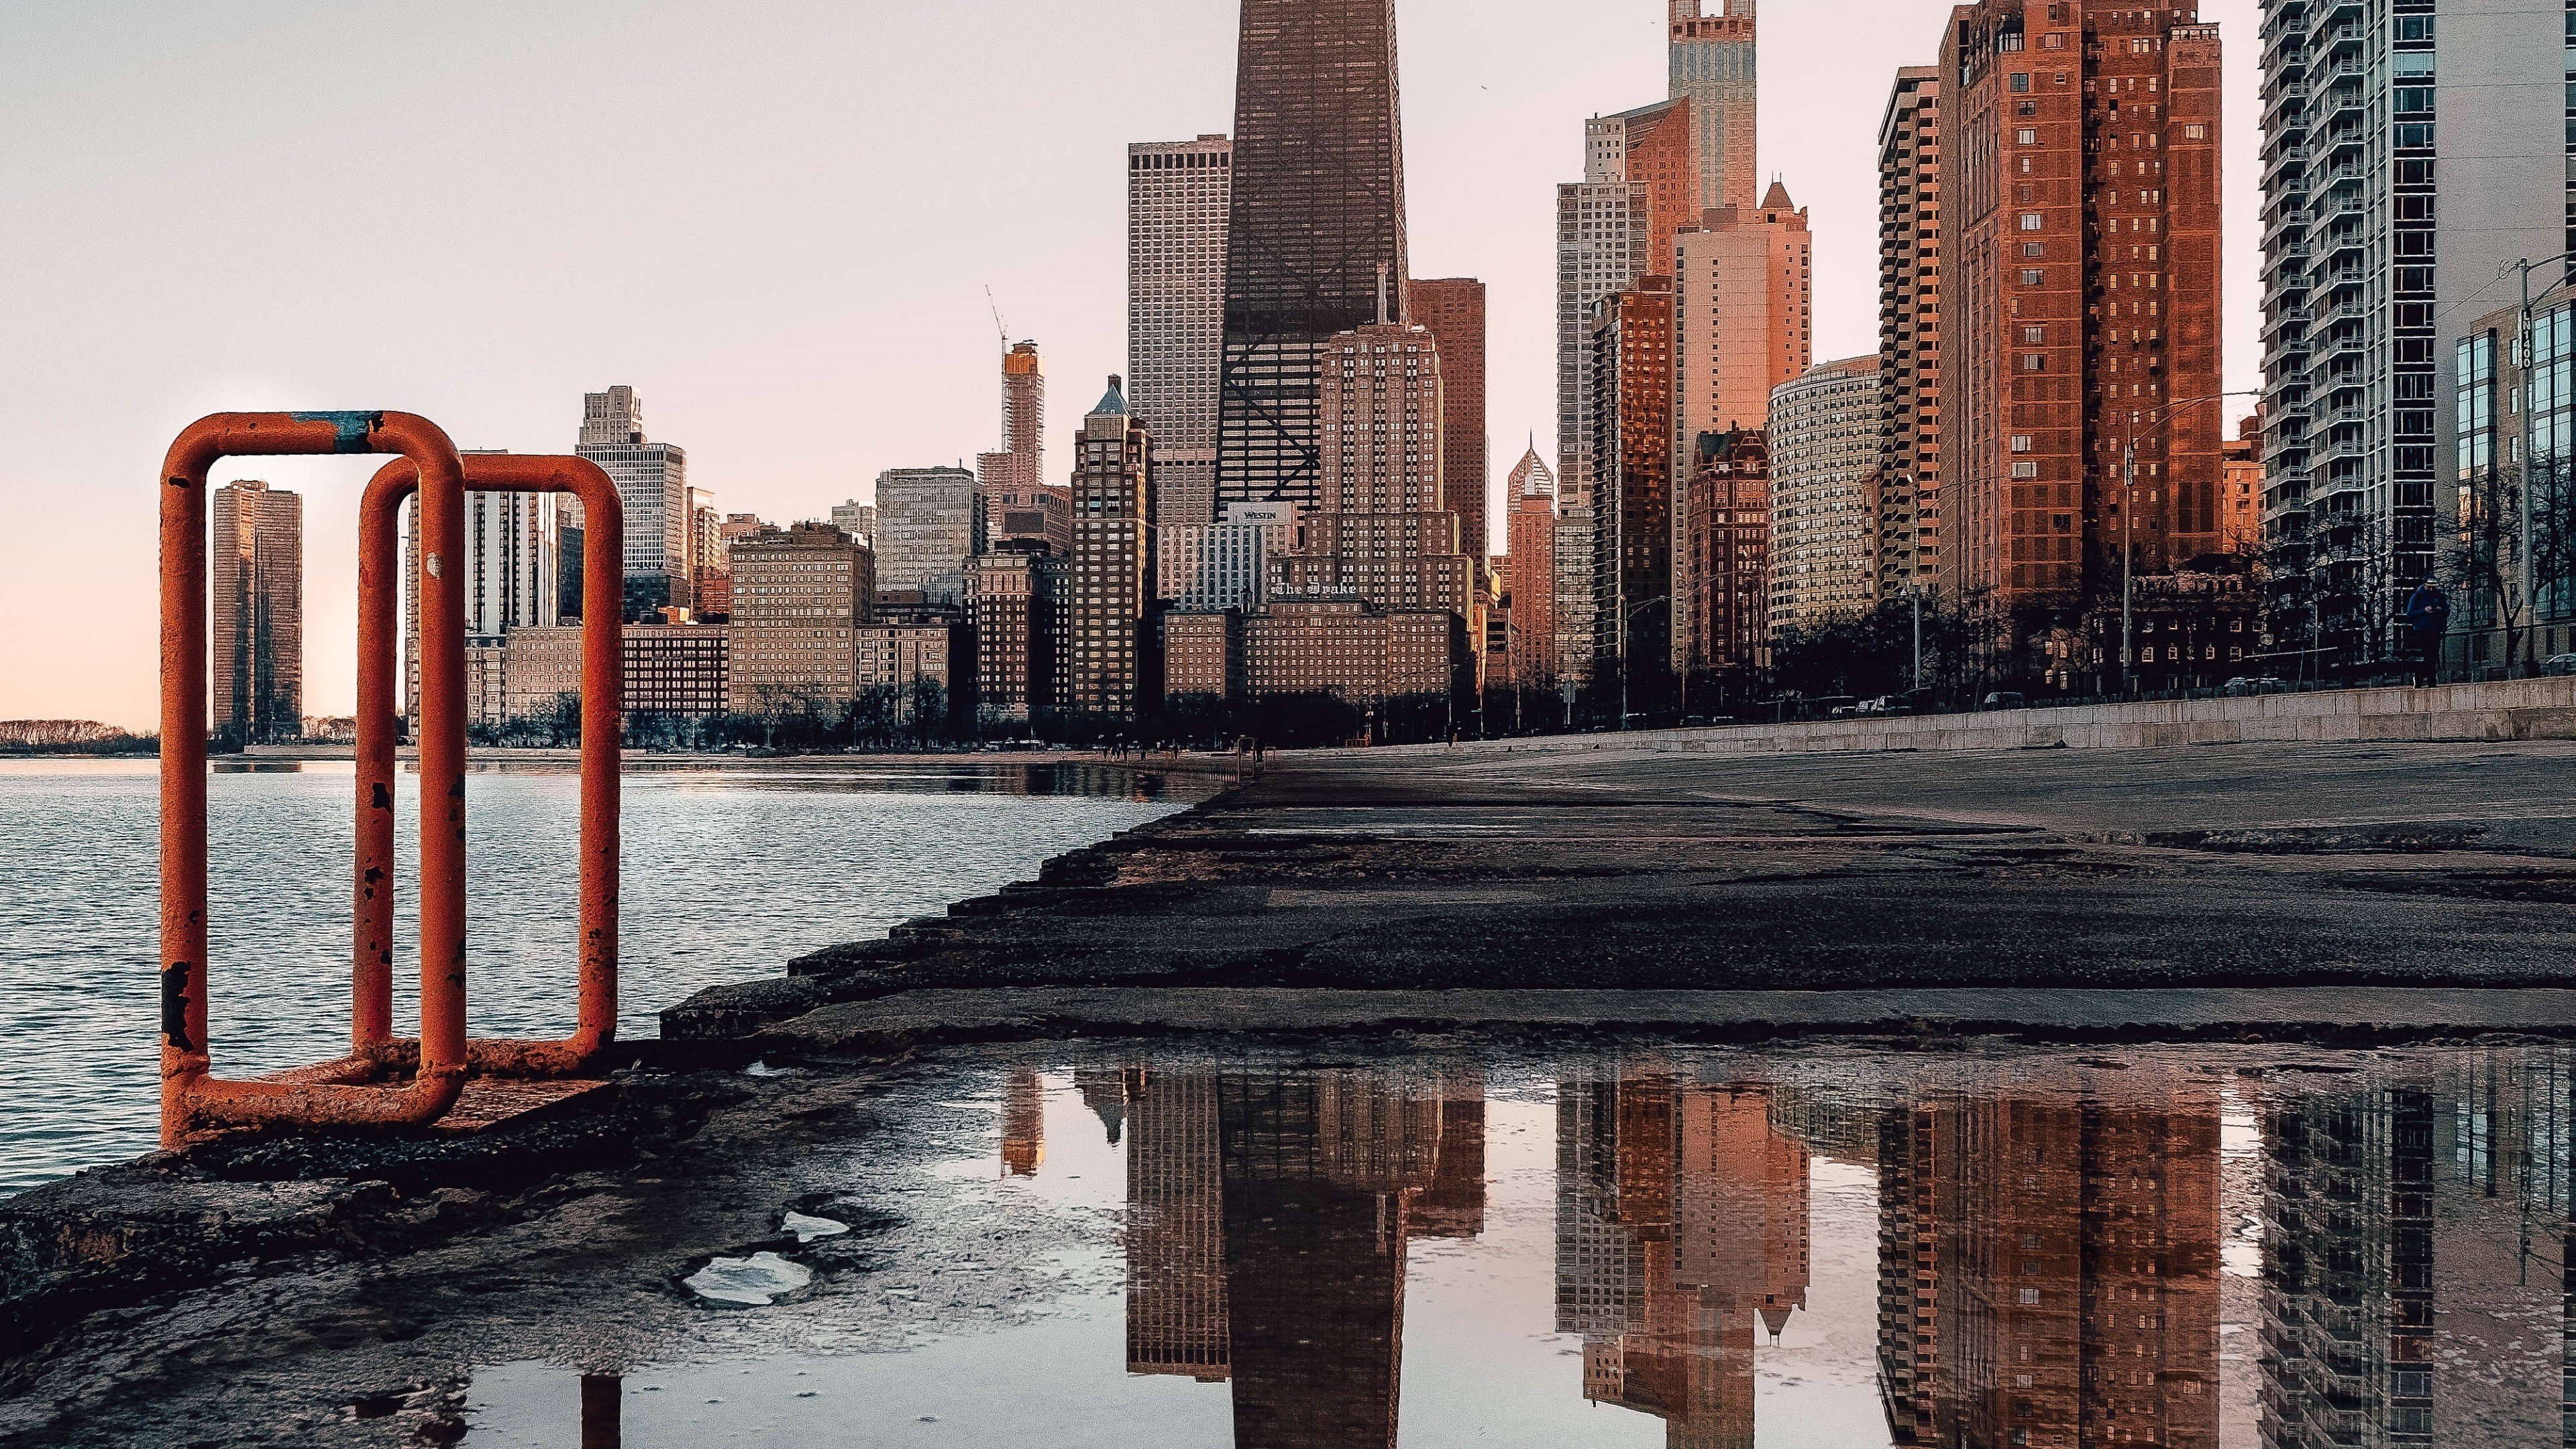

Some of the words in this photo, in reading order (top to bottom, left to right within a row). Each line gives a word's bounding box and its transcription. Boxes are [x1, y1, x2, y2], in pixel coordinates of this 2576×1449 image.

[2522, 311, 2530, 367] LN1400
[1244, 511, 1276, 519] WESTIN
[1276, 582, 1302, 594] The
[1307, 582, 1356, 594] Drake
